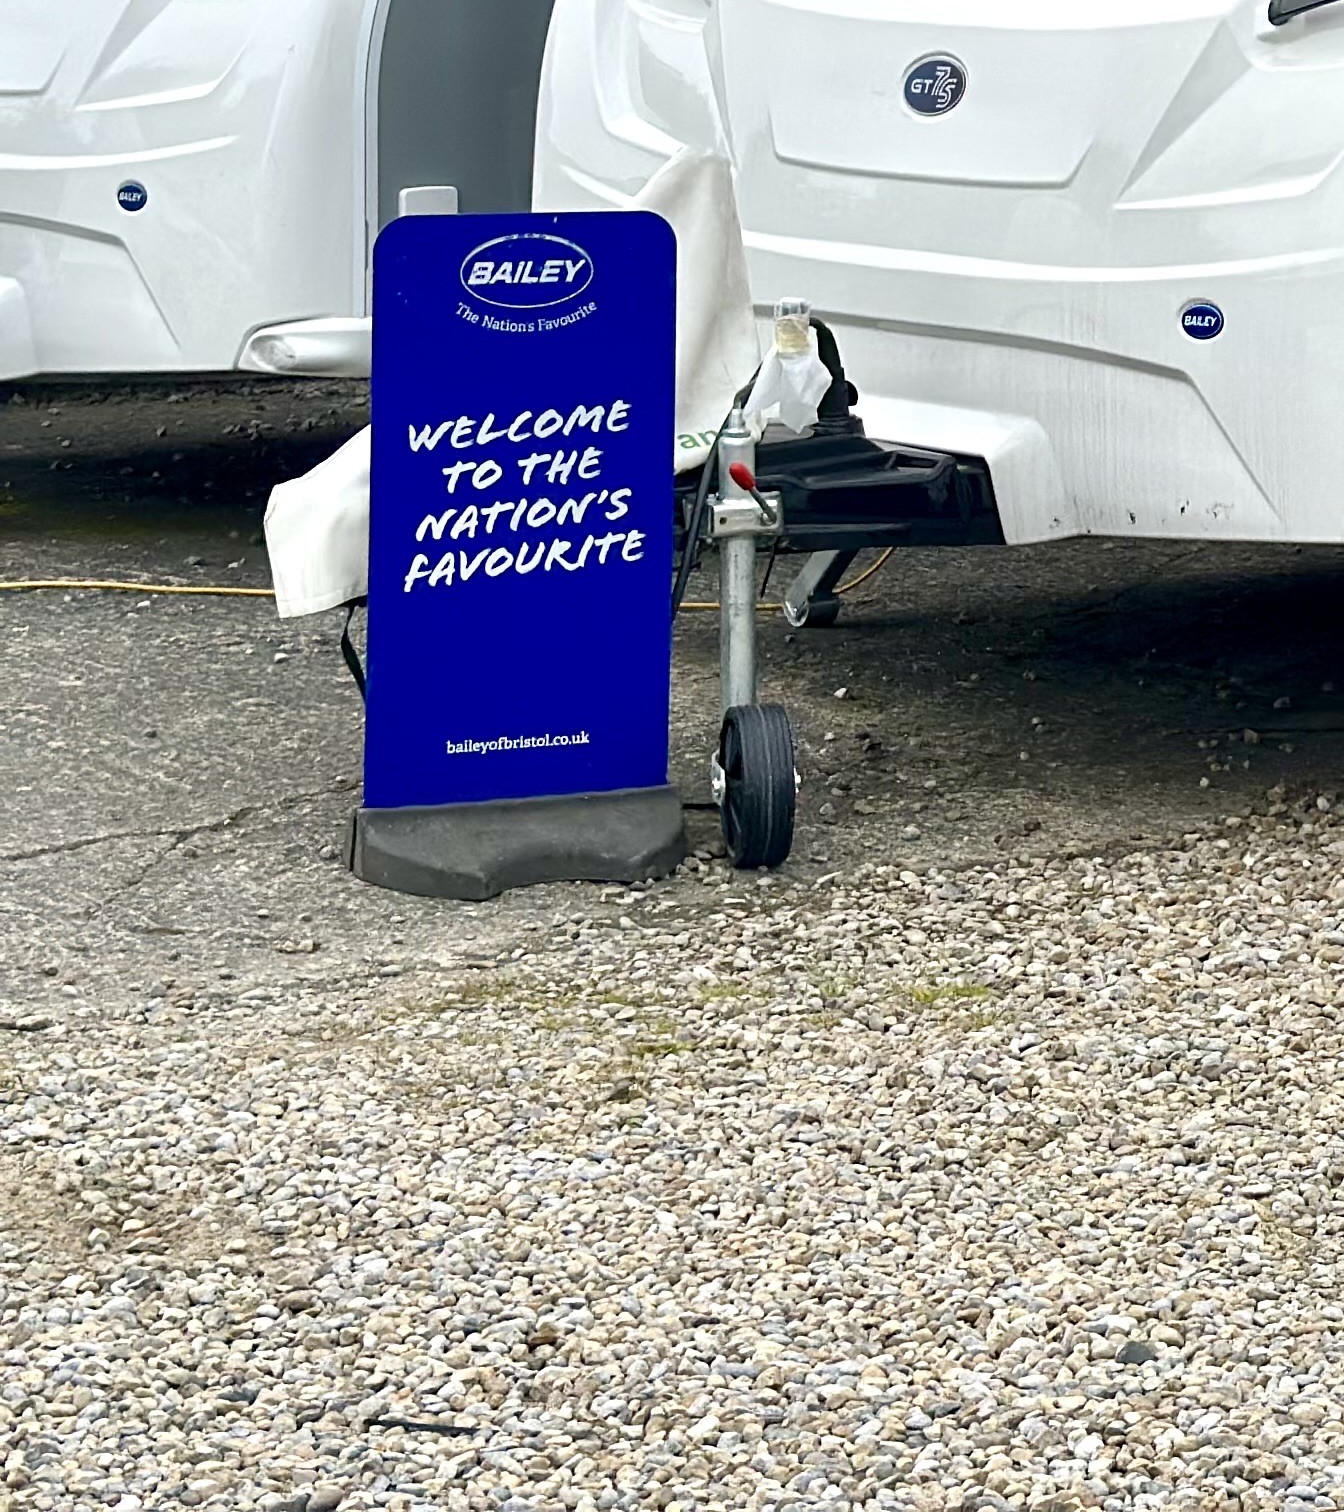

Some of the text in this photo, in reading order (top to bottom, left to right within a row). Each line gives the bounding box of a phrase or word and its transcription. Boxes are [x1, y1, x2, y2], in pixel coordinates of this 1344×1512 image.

[119, 192, 142, 201] BAILEY
[467, 259, 586, 285] BAILEY
[455, 302, 480, 324] The
[537, 301, 597, 332] Favourite
[1184, 316, 1217, 326] BAILEY
[408, 399, 633, 453] WELCOME
[442, 446, 604, 494] TO THE
[415, 488, 632, 543] NATION'S
[404, 529, 647, 594] FAVOURITE
[446, 731, 590, 755] baileyofbristol.co.uk
